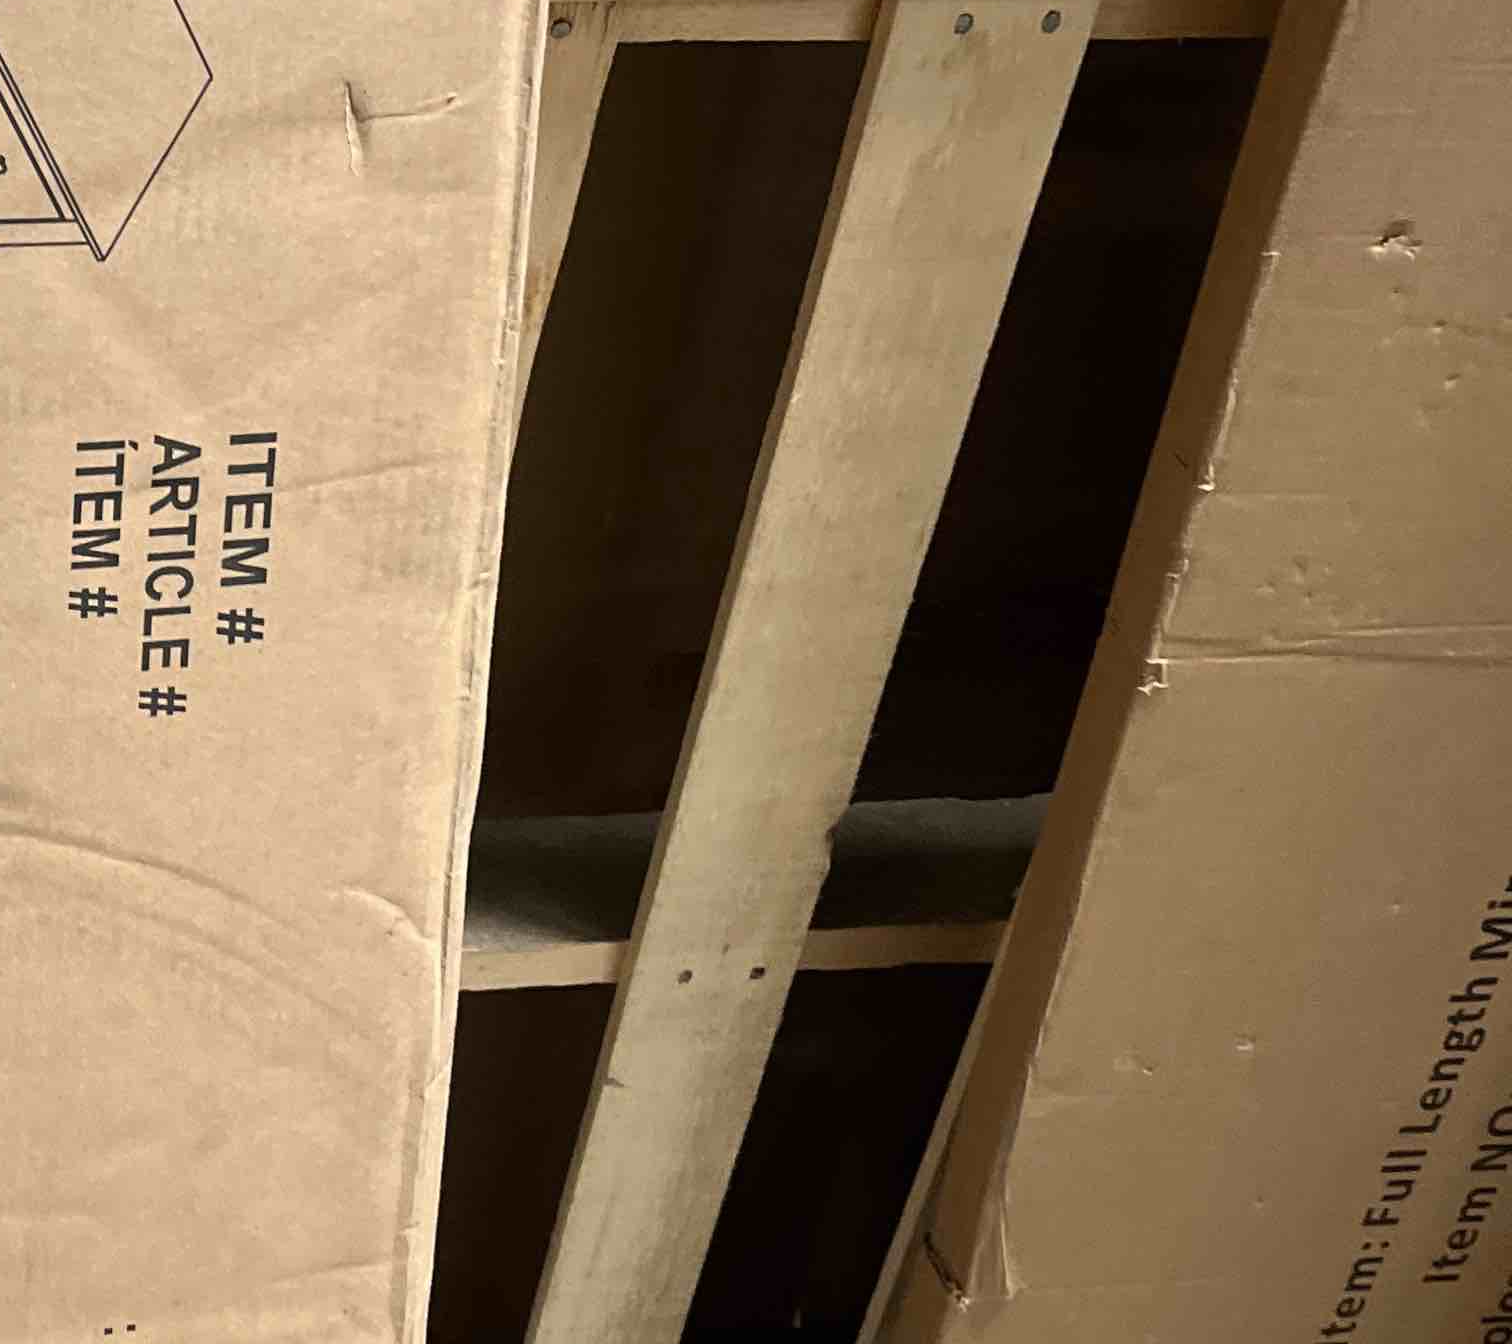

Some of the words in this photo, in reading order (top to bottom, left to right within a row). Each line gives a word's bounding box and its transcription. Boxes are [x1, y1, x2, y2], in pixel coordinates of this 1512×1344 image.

[70, 439, 139, 570] ÍTEM
[141, 434, 202, 672] ARTICLE
[220, 431, 278, 587] ITEM
[67, 586, 119, 619] #
[215, 607, 265, 645] #
[138, 686, 188, 718] #
[1361, 1148, 1428, 1229] Full
[1399, 976, 1500, 1136] Length
[1470, 875, 1511, 961] Mi
[1422, 1185, 1498, 1284] Item
[1470, 1093, 1511, 1171] NO
